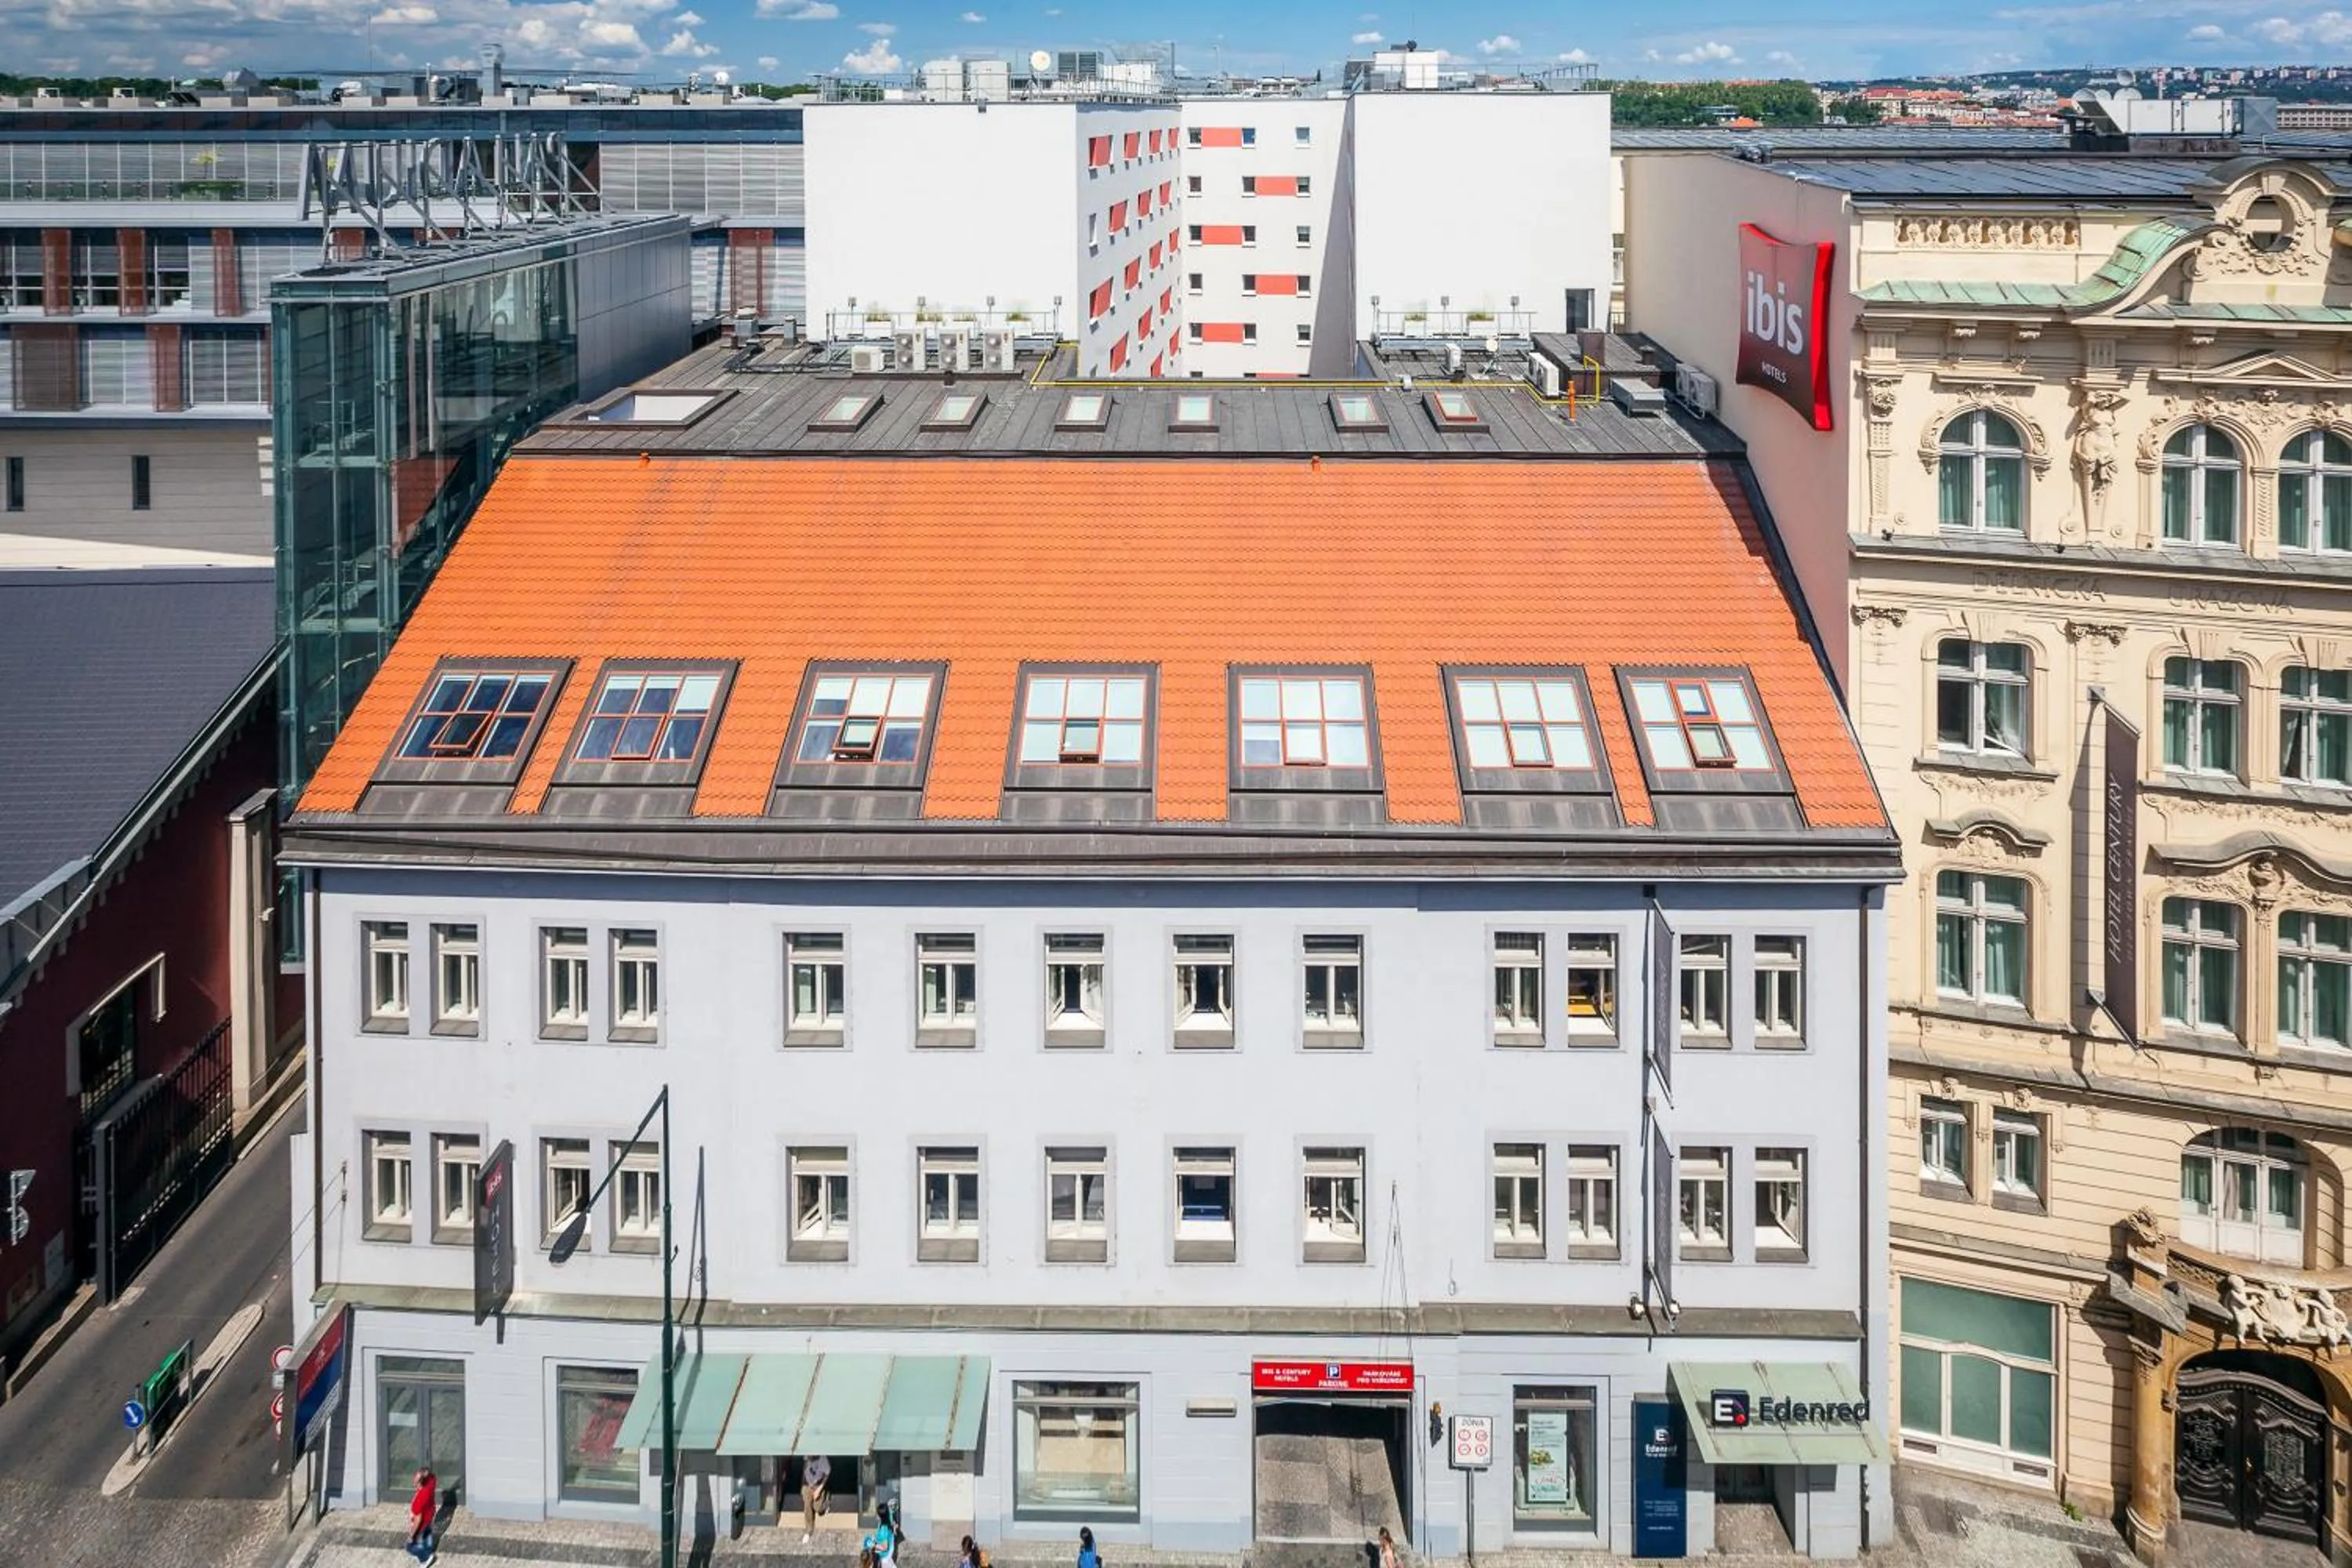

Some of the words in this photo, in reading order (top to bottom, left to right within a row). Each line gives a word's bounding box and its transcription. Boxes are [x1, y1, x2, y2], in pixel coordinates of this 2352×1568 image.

[1747, 270, 1803, 355] ibis
[1762, 361, 1787, 383] HOTELS
[2107, 771, 2122, 882] CENTURY
[2107, 887, 2122, 964] HOTEL
[1329, 1367, 1338, 1377] P
[1759, 1396, 1870, 1421] Edenred
